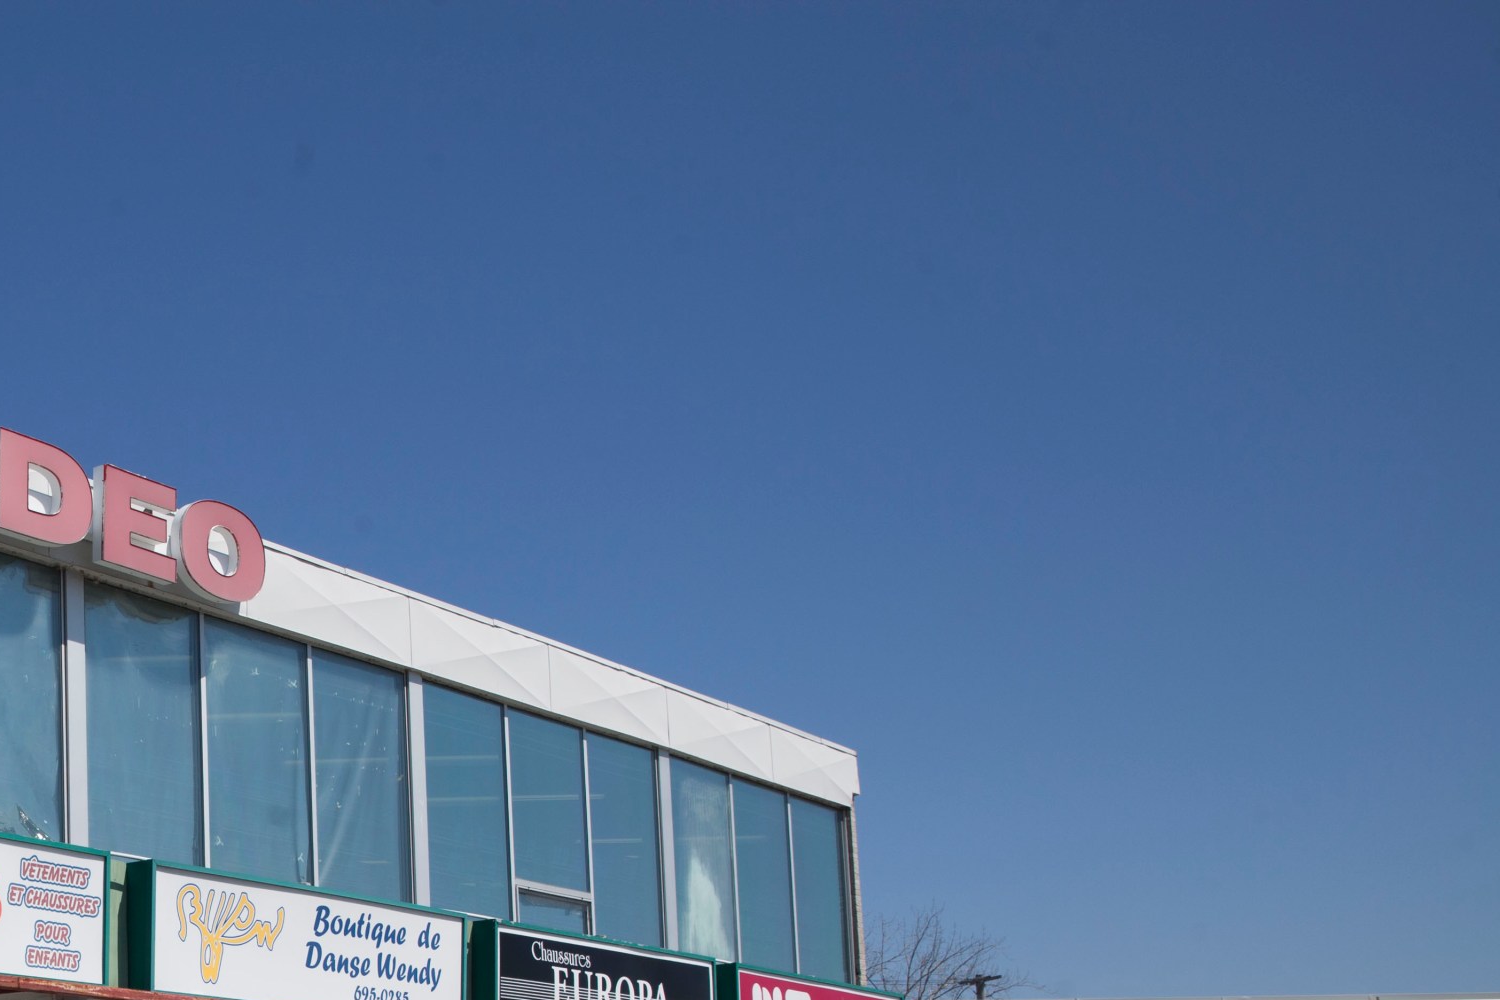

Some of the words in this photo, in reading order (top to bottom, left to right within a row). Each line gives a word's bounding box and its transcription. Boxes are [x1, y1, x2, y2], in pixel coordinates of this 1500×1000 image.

[19, 855, 91, 890] VÊTEMENTS
[7, 884, 25, 907] ET
[24, 887, 101, 918] CHAUSSURES
[34, 920, 71, 947] POUR
[313, 905, 407, 949] Boutique
[417, 922, 441, 951] de
[25, 945, 81, 972] ENFANTS
[305, 941, 371, 978] Danse
[376, 952, 442, 992] Wendy
[531, 941, 592, 969] Chaussures
